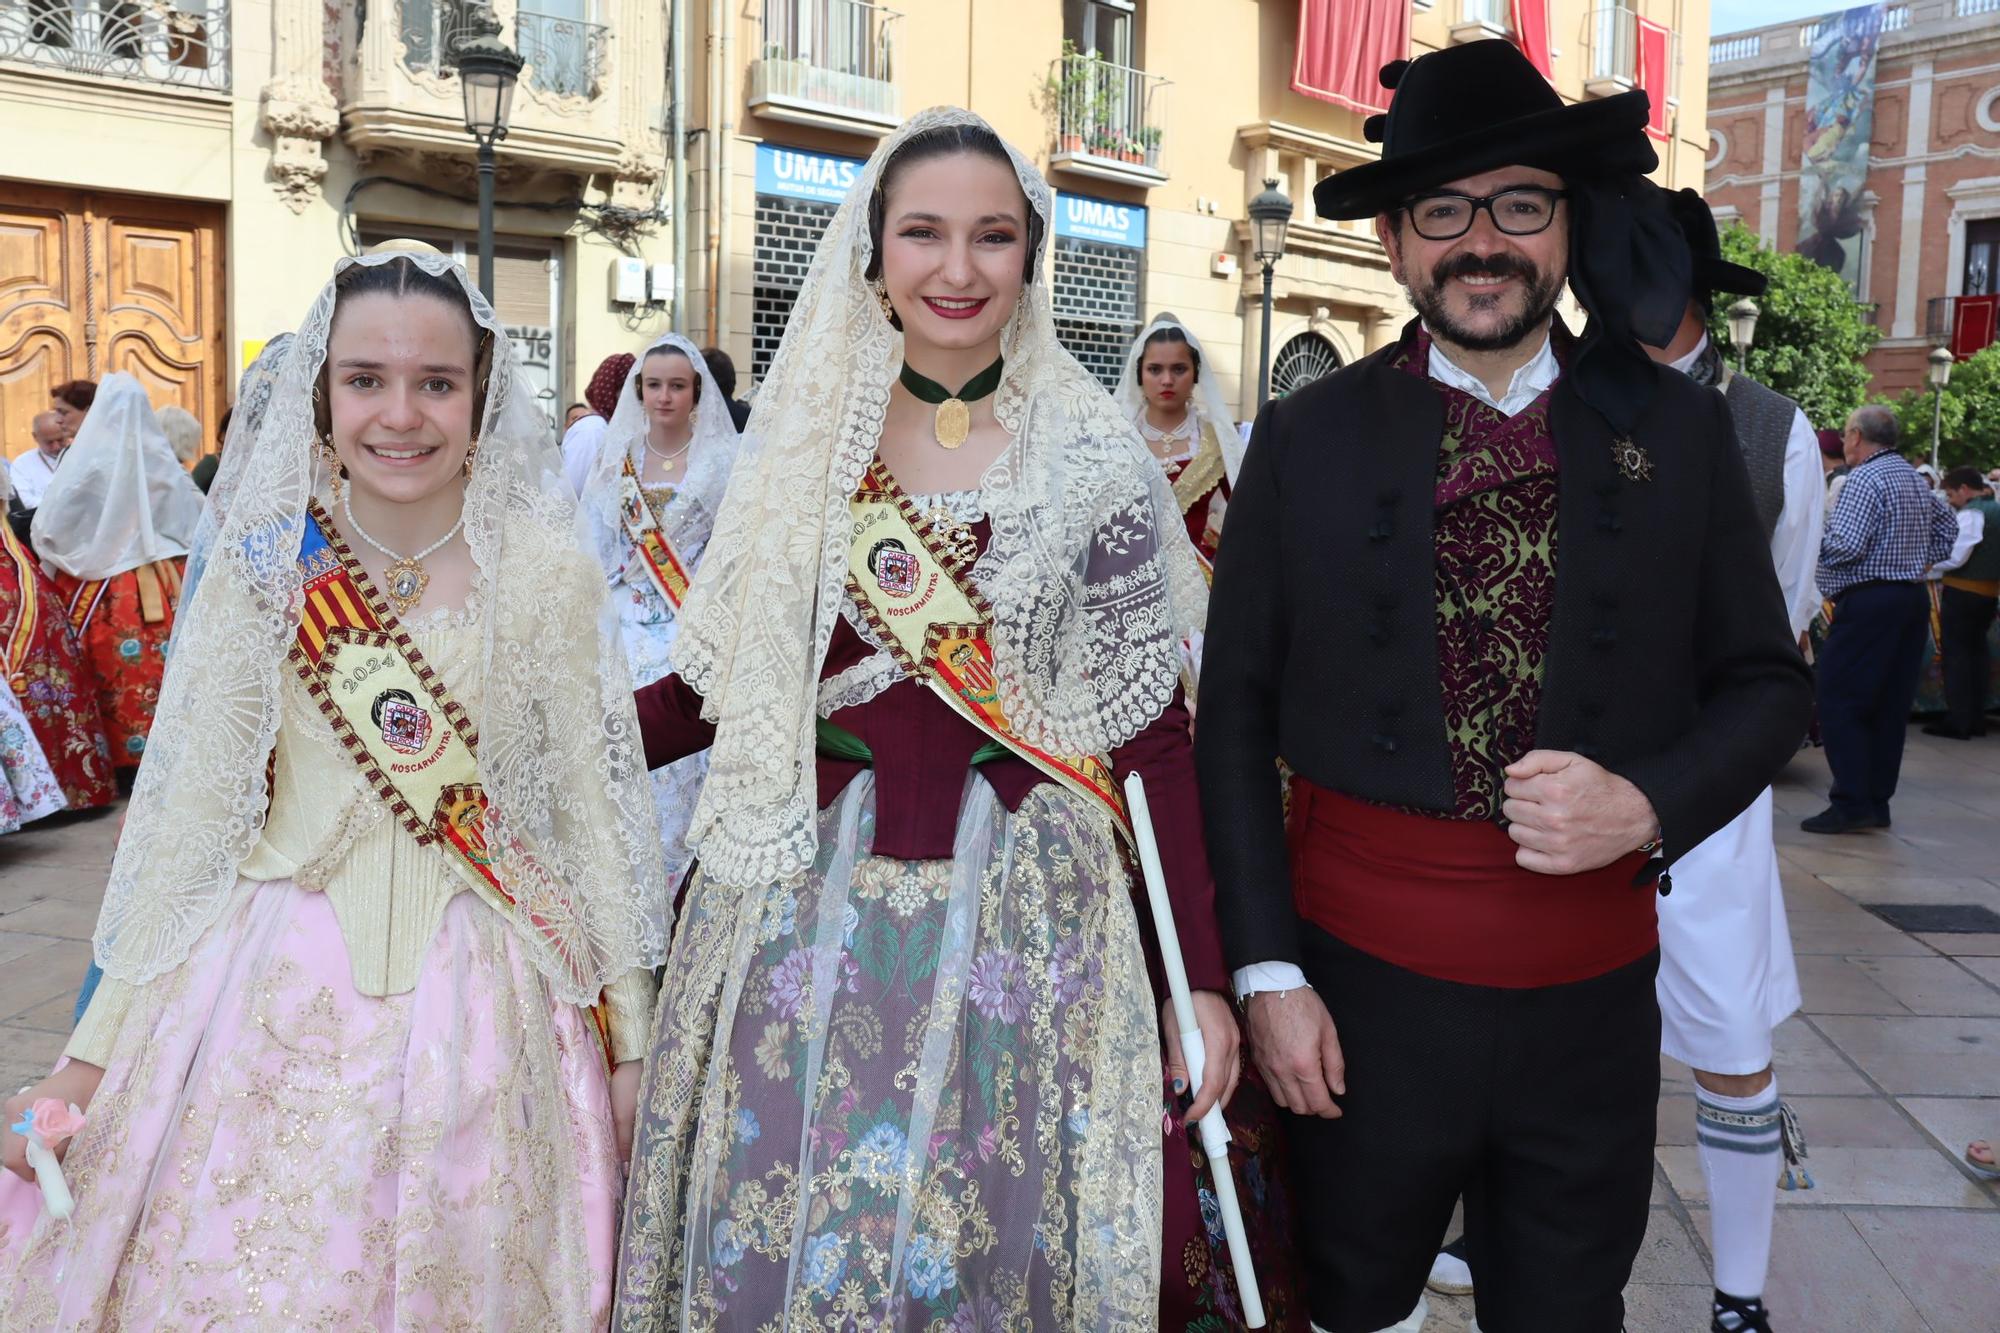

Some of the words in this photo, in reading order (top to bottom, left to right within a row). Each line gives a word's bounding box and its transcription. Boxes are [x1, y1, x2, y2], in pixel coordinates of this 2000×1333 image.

[774, 150, 855, 188] UMAS
[1067, 197, 1130, 231] UMAS
[886, 572, 939, 618] NOSCARMIENTAS
[342, 653, 396, 695] 2024
[390, 730, 452, 773] NOSCARMIENTAS
